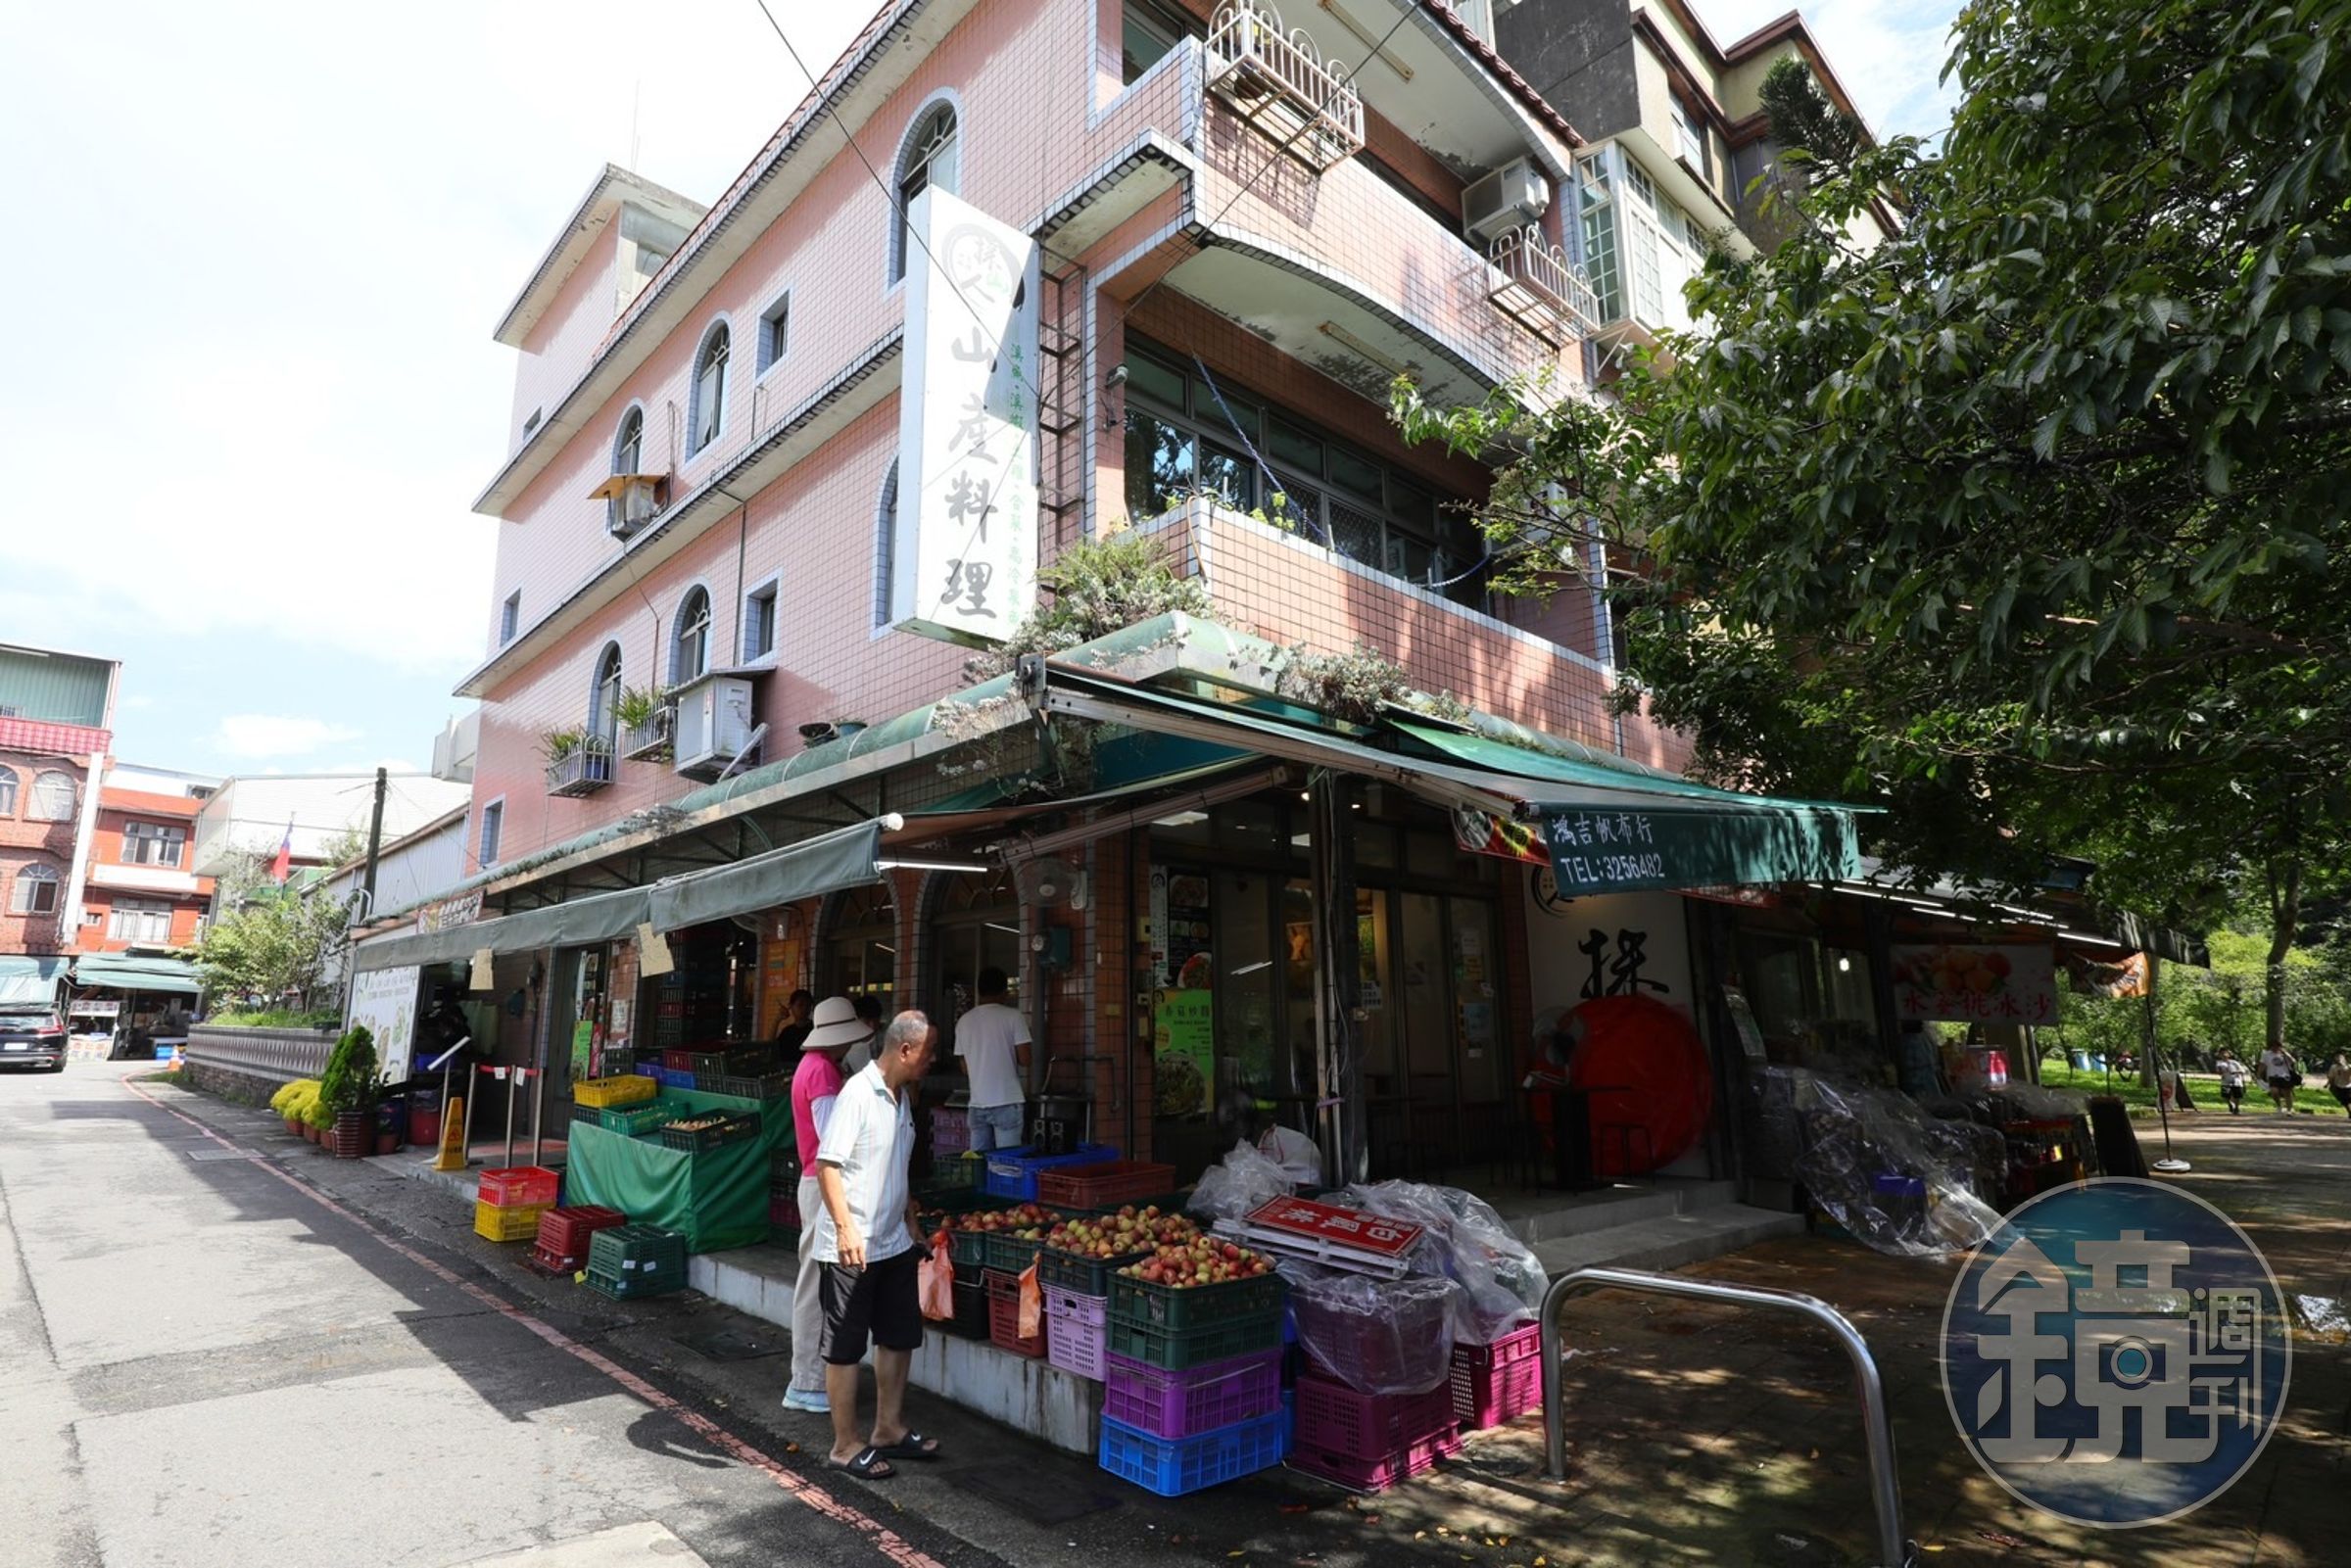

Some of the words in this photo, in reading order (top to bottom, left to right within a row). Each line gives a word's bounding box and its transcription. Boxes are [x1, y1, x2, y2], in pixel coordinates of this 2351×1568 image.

[940, 326, 999, 619] 山產料理
[1552, 812, 1654, 846] 鴻吉帆布行
[1559, 853, 1665, 884] TEL:3256482
[1904, 989, 2051, 1020] 水蜜桃冰沙
